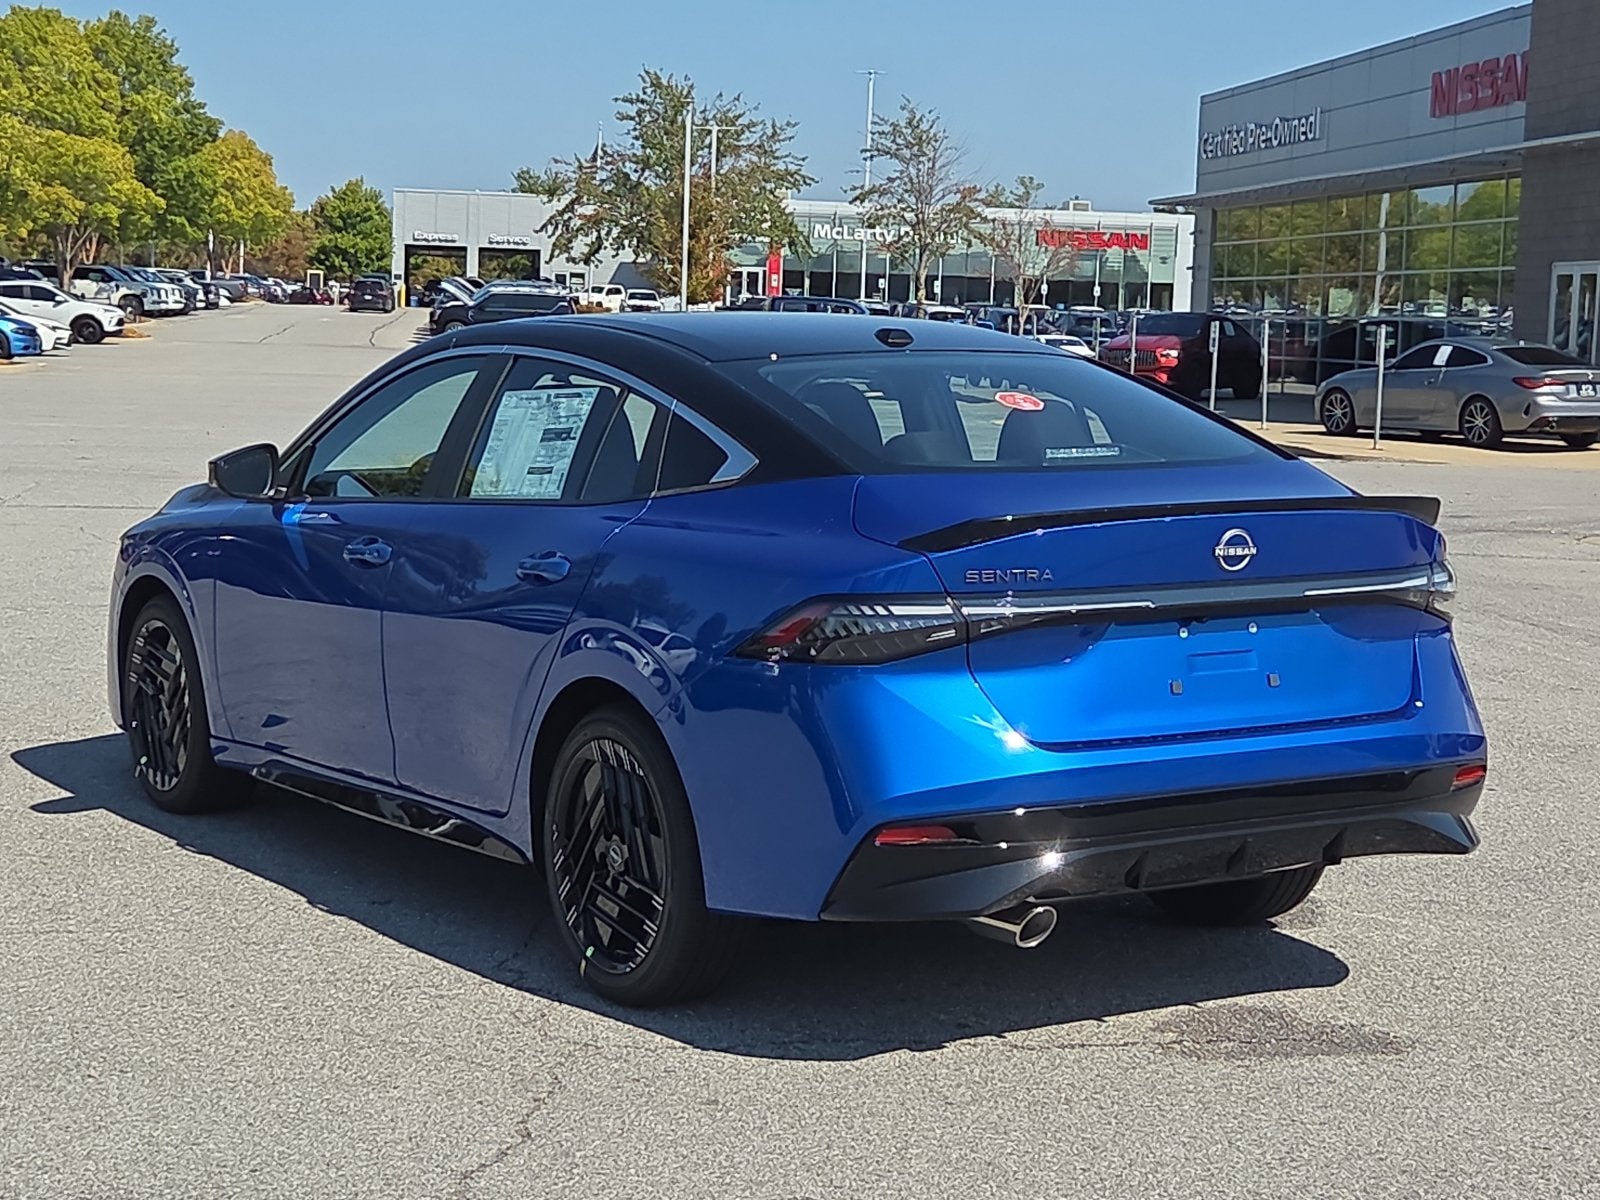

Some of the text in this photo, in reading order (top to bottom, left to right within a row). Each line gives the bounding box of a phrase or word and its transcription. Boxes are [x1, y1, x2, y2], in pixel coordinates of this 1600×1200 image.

[1201, 107, 1320, 159] Certified Pre-Owned
[413, 230, 459, 243] Express
[488, 232, 531, 245] Service
[813, 223, 896, 244] McLarty
[1037, 229, 1149, 250] NISSAN
[1215, 546, 1257, 556] NISSAN
[965, 568, 1054, 583] SENTRA
